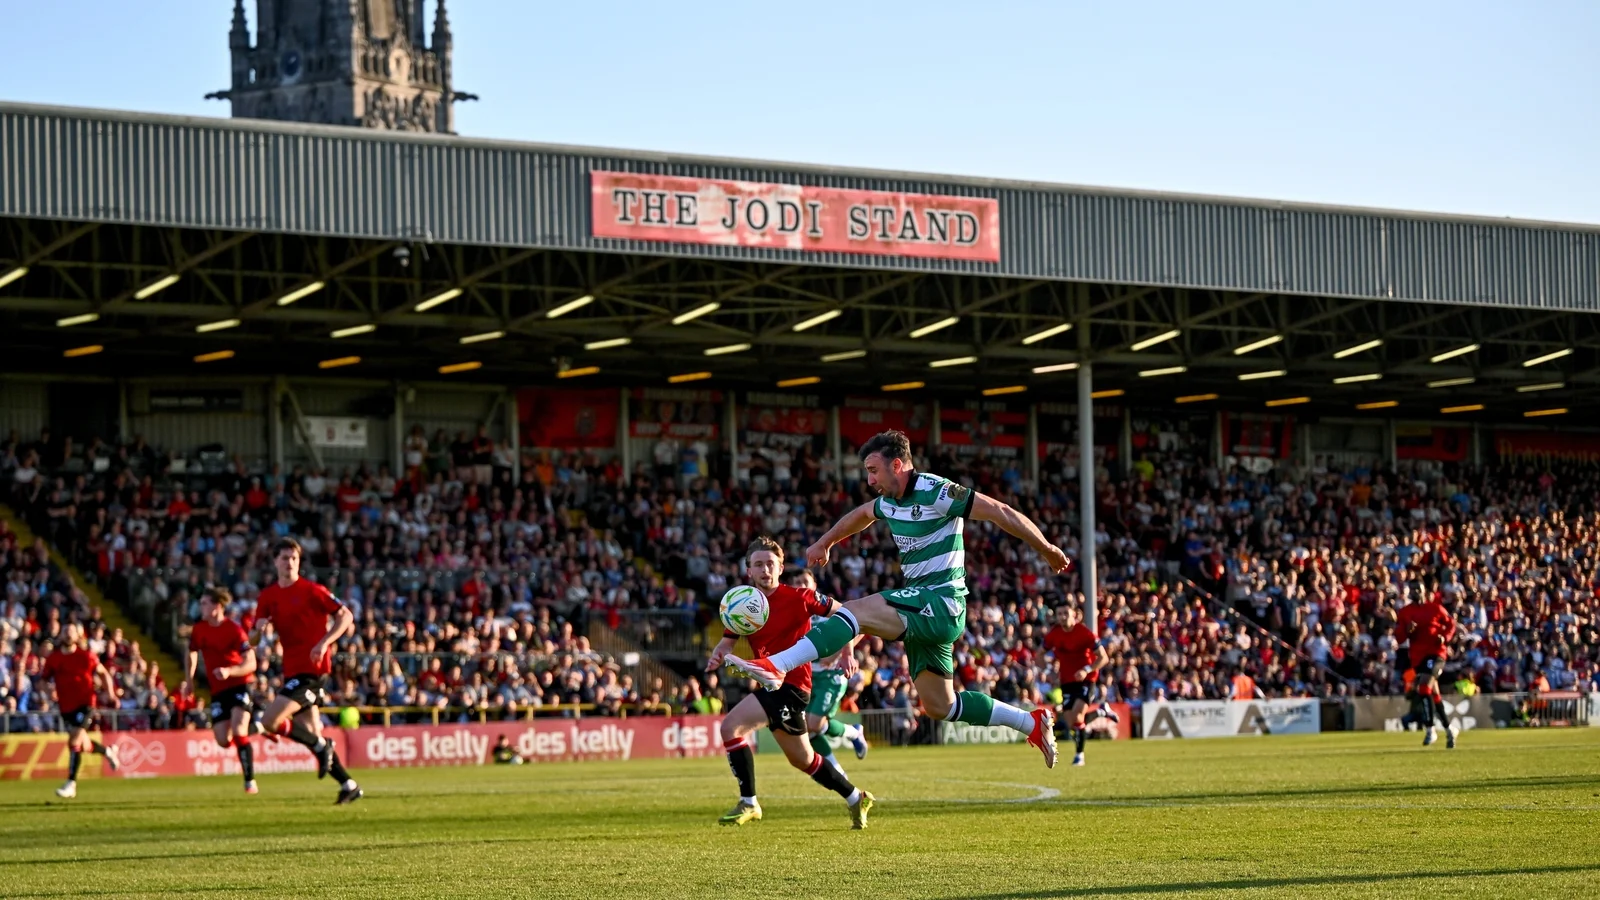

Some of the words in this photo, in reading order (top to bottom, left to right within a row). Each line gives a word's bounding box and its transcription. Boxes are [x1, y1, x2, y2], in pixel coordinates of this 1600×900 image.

[613, 189, 698, 226] THE
[721, 198, 821, 236] JODI
[848, 205, 980, 244] STAND
[366, 731, 418, 762] des
[422, 729, 489, 765] kelly
[518, 727, 567, 757] des
[571, 723, 635, 761] kelly
[662, 721, 709, 751] des
[194, 758, 220, 775] for
[223, 757, 317, 775] Bradband
